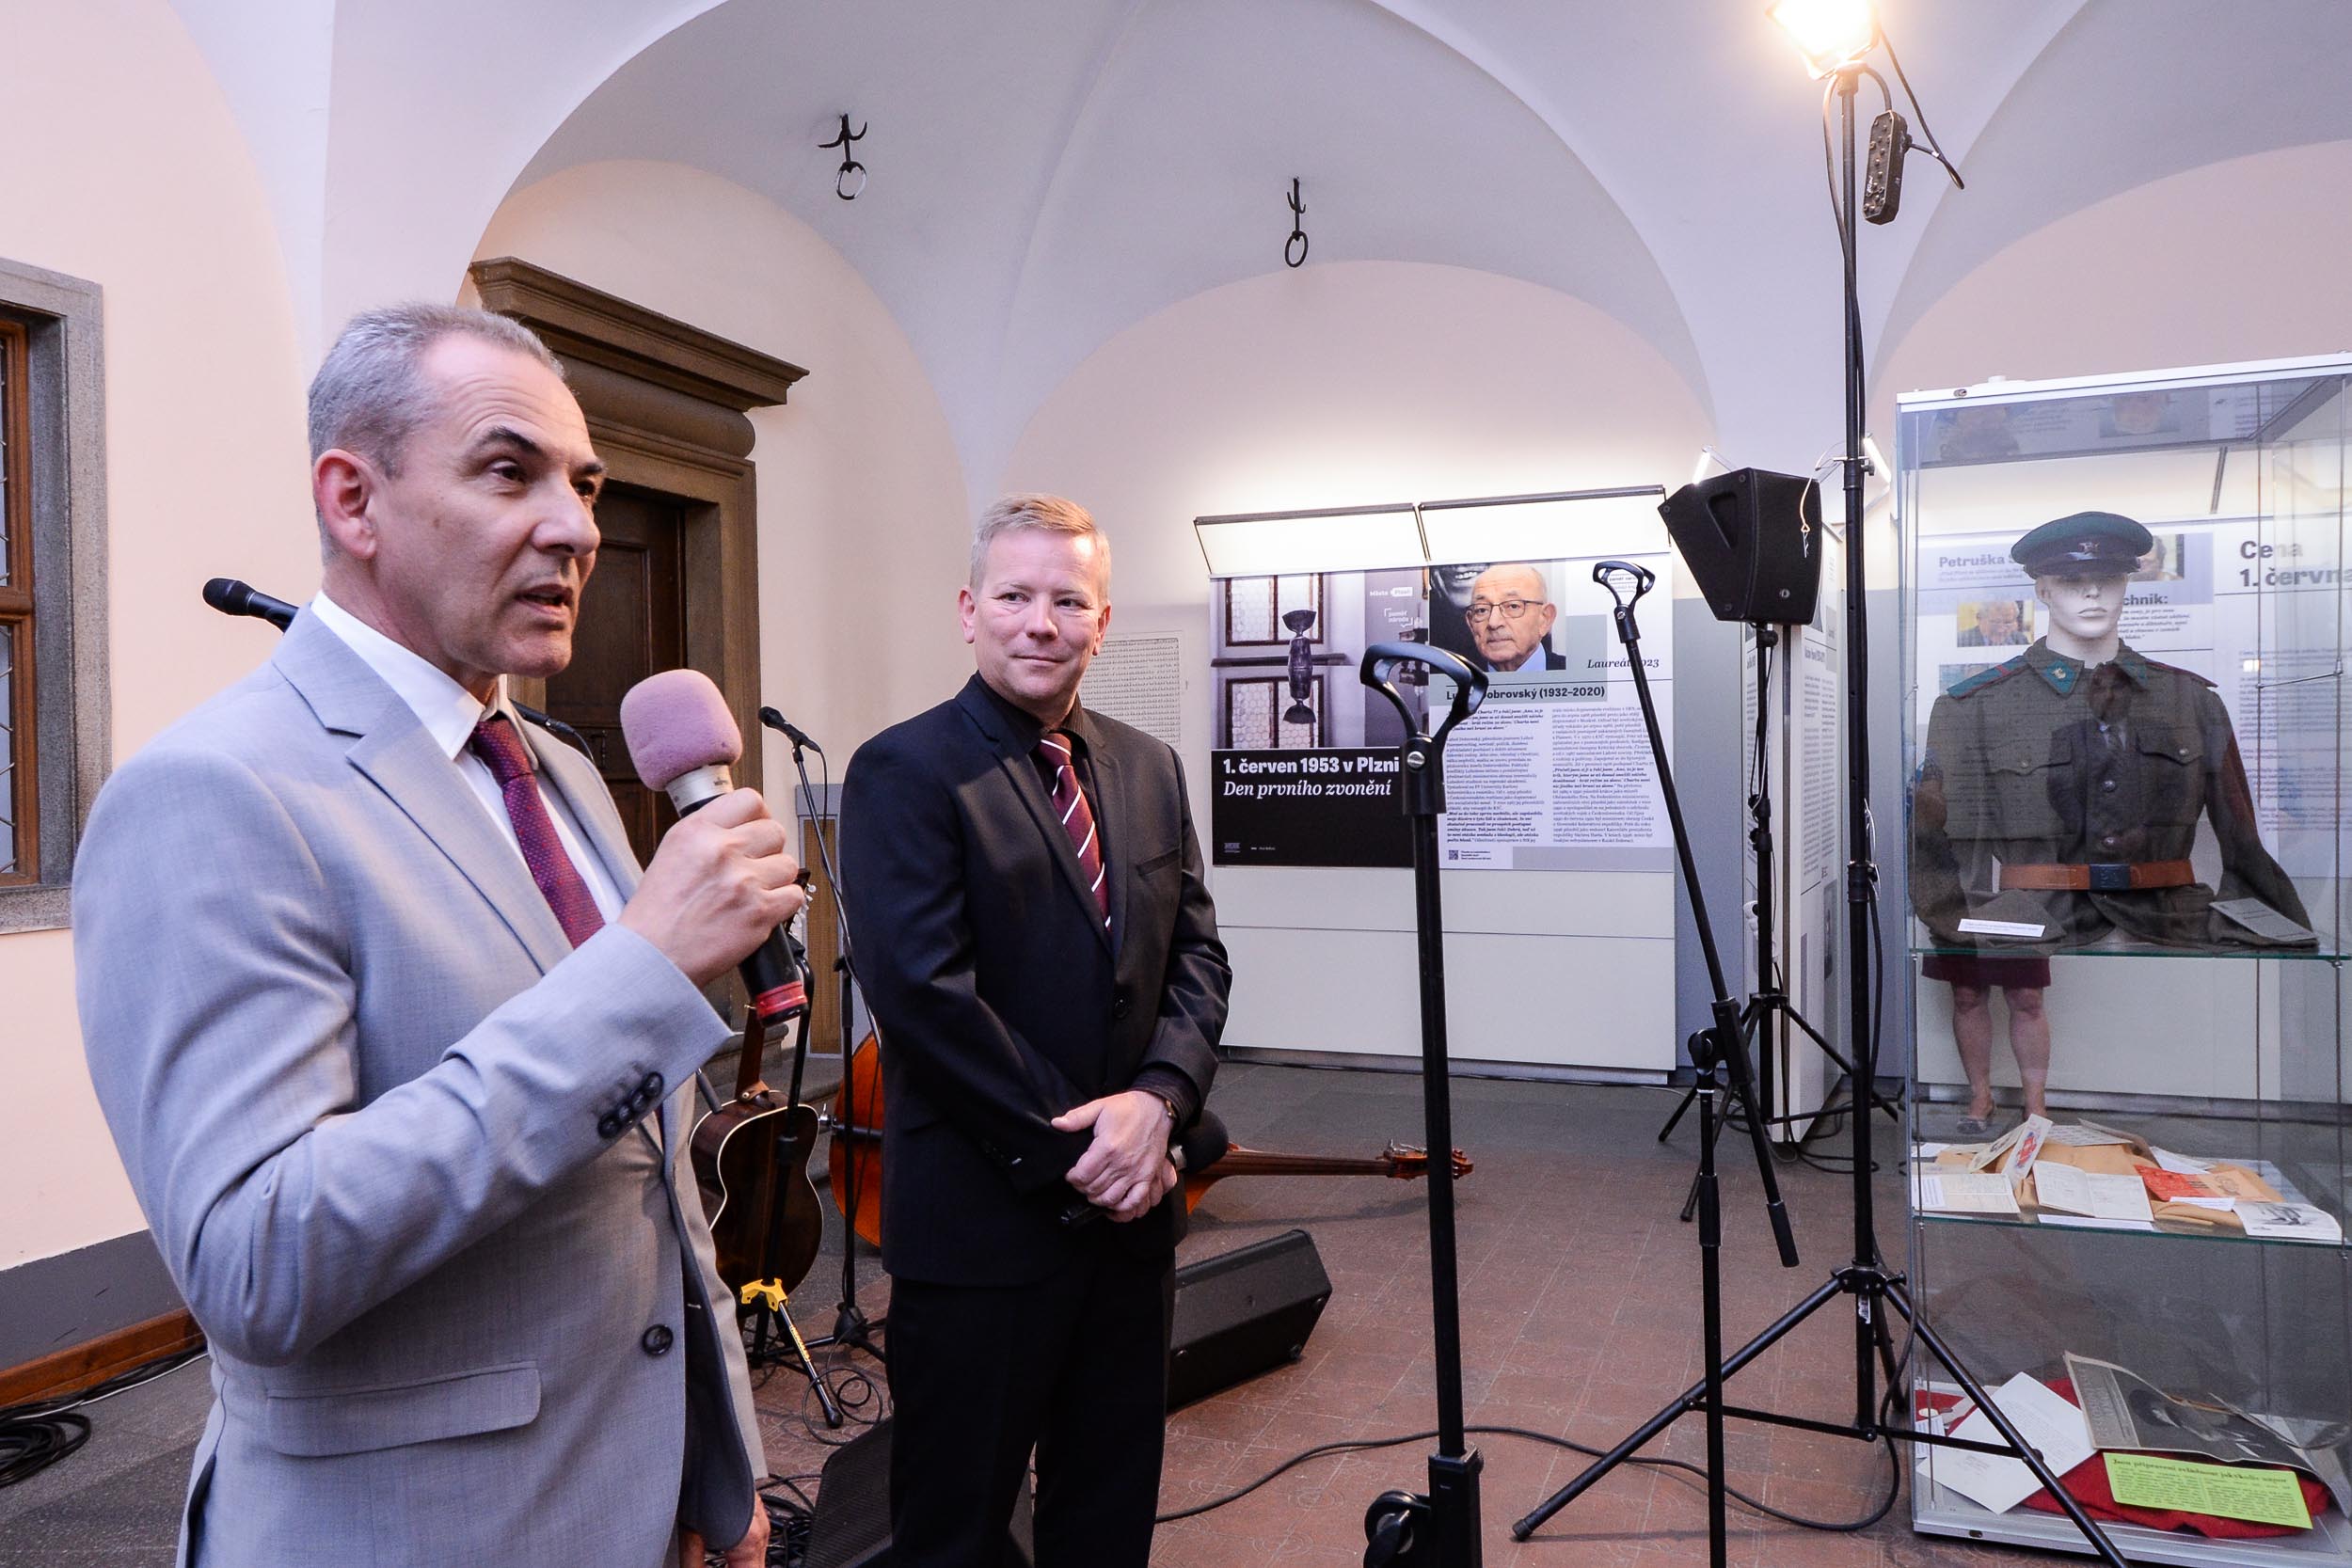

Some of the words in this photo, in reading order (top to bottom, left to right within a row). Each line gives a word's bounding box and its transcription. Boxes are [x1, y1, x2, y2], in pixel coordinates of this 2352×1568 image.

[2240, 540, 2304, 559] Cena
[1939, 553, 2005, 568] Petruška
[2240, 569, 2259, 587] 1.
[2122, 594, 2168, 606] chnik:
[1487, 688, 1536, 700] obrovský
[1223, 758, 1236, 774] 1.
[1239, 758, 1297, 774] červen
[1300, 757, 1339, 773] 1953
[1343, 761, 1354, 772] v
[1357, 756, 1400, 772] Plzni
[1223, 781, 1254, 796] Den
[1256, 780, 1322, 799] prvního
[1325, 779, 1392, 796] zvonění
